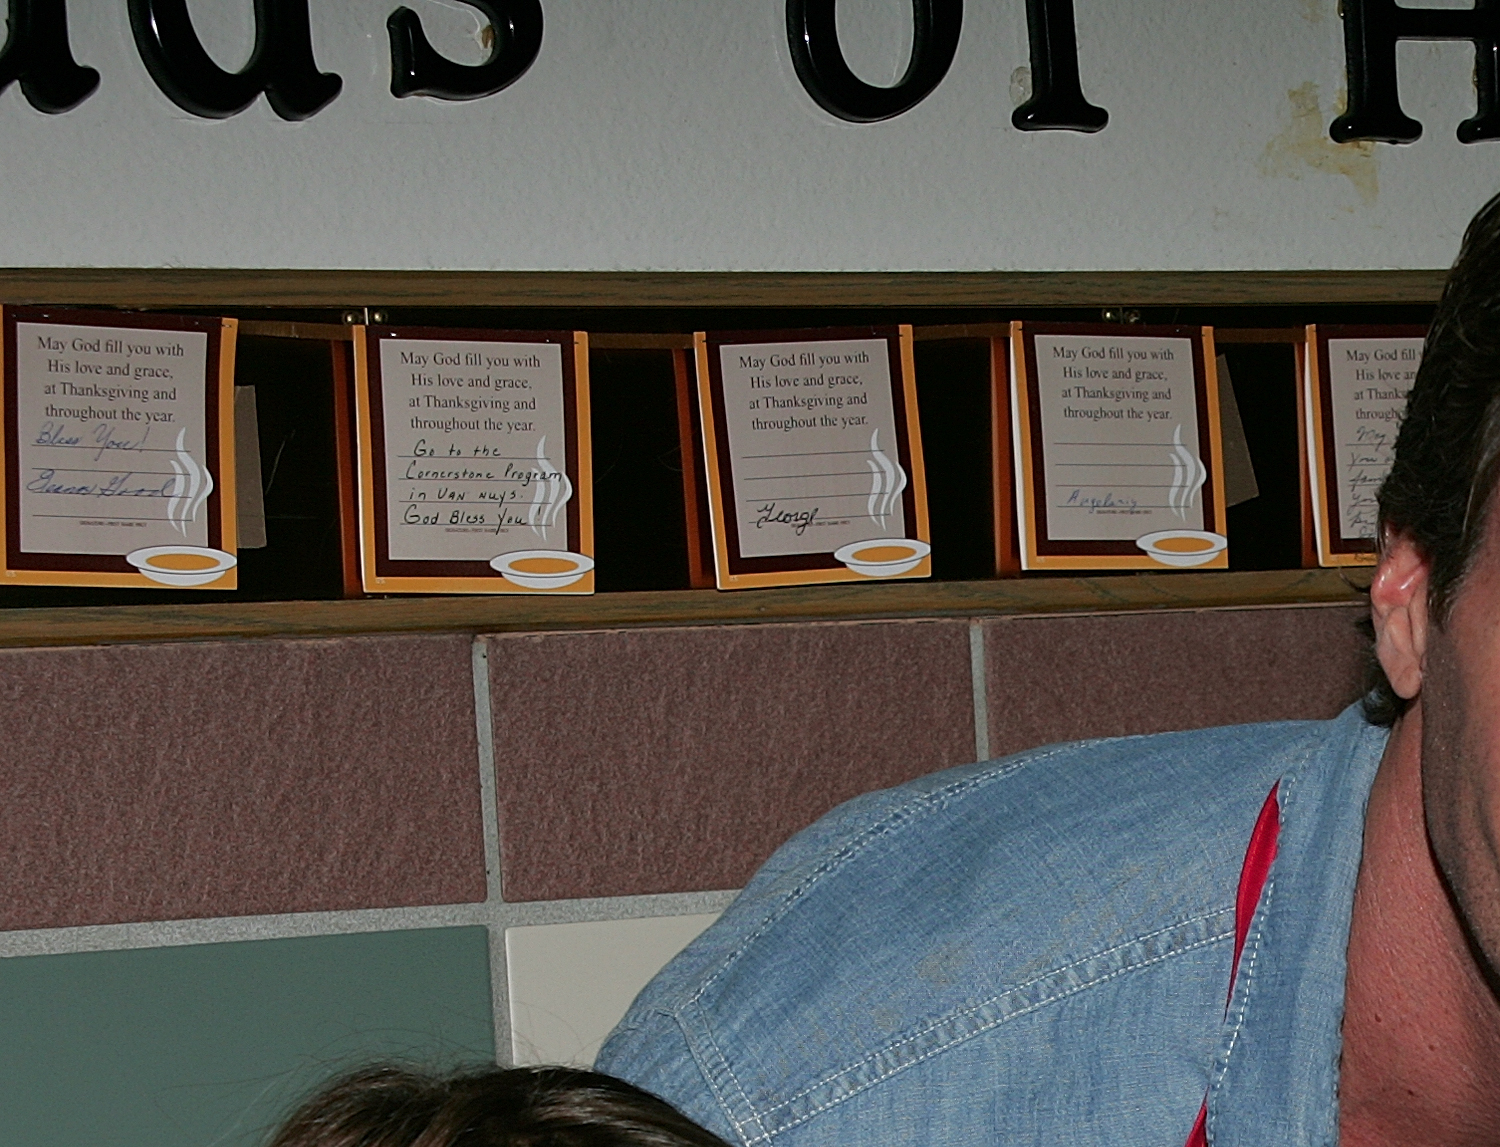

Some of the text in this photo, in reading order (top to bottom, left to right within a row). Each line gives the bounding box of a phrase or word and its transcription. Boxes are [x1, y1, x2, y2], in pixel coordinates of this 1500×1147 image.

[37, 337, 184, 358] May God fill you with
[1052, 346, 1174, 363] May God fill you with
[1346, 348, 1416, 364] May God fill
[48, 360, 173, 380] His love and grace,
[400, 352, 540, 370] May God fill you with
[739, 351, 869, 371] May God fill you with
[411, 373, 532, 392] His love and grace,
[750, 373, 863, 389] His love and grace,
[1063, 366, 1168, 383] His love and grace,
[1355, 368, 1417, 381] His love an
[44, 383, 176, 403] at Thanksgiving and
[749, 392, 867, 410] at Thanksgiving and
[1061, 386, 1172, 403] at Thanksgiving and
[1353, 386, 1406, 400] at Thank
[408, 395, 536, 413] at Thanksgiving and
[45, 405, 175, 425] throughout the year.
[1063, 405, 1172, 422] throughout the year.
[1355, 406, 1400, 424] through
[410, 416, 535, 434] throughout the year.
[751, 414, 868, 432] throughout the year.
[36, 421, 83, 445] Bless
[413, 439, 501, 457] Go to the
[405, 460, 562, 486] Cornerstone Program
[409, 488, 427, 500] in
[404, 504, 439, 524] God
[450, 510, 486, 524] Bless
